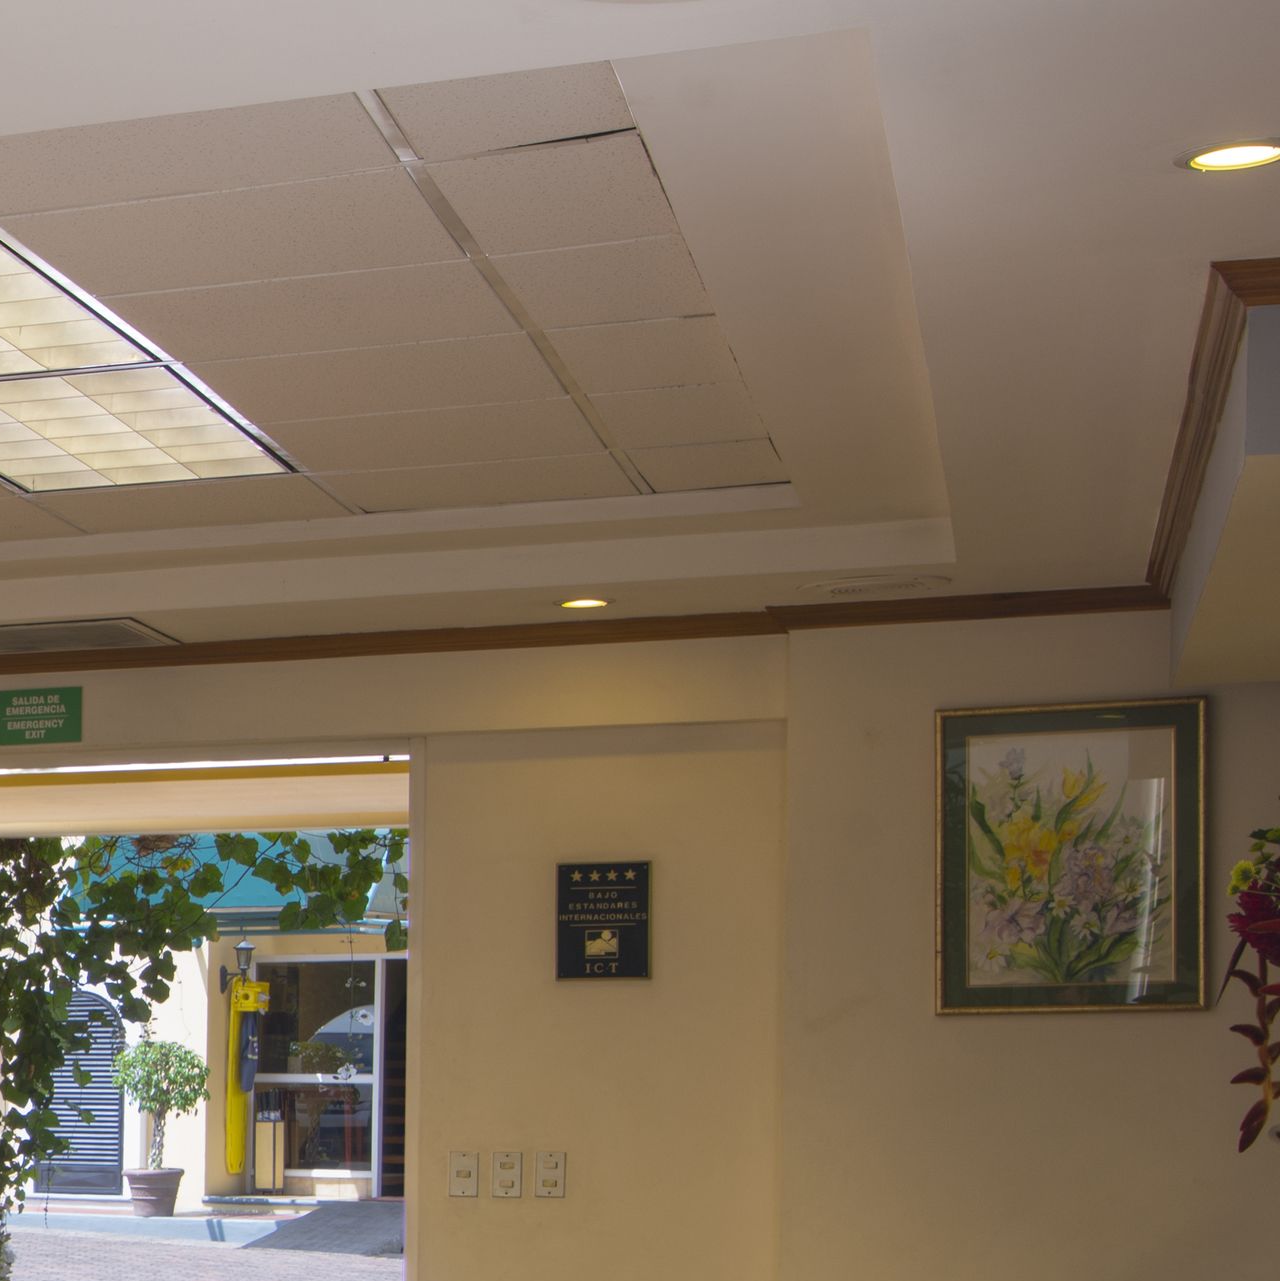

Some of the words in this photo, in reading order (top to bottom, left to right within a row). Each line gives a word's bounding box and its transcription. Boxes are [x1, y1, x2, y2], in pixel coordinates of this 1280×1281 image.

[12, 696, 44, 706] SALIDA
[47, 695, 60, 704] DE
[6, 704, 66, 716] EMERGENCIA
[7, 719, 64, 730] EMERGENCY
[25, 730, 46, 739] EXIT
[588, 891, 618, 899] BAJO
